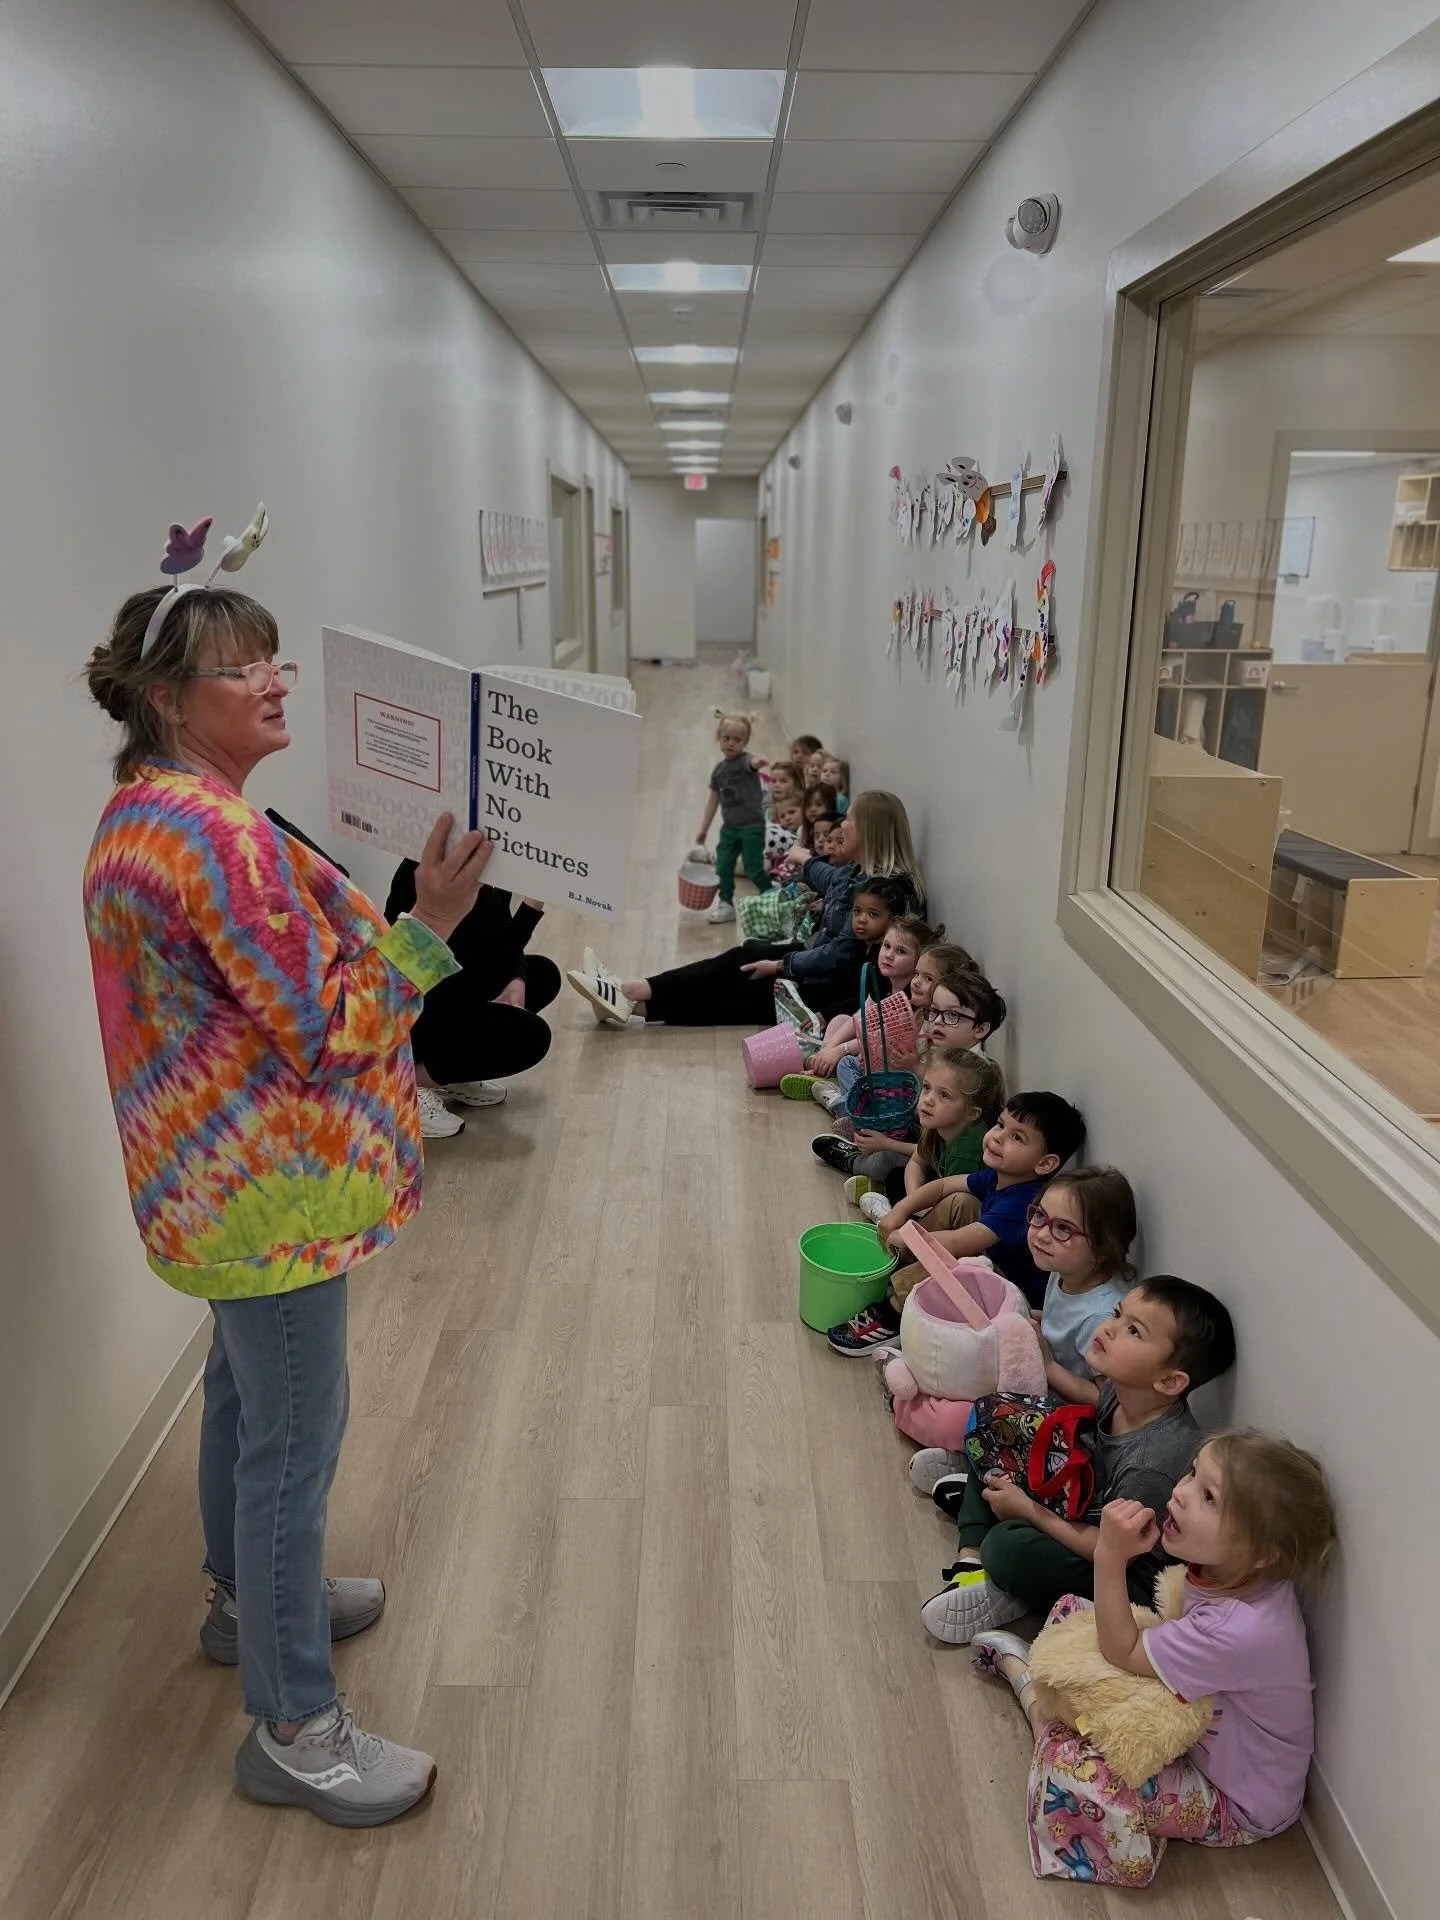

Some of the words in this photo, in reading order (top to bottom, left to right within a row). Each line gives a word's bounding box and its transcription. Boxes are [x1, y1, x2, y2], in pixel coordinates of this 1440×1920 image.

[488, 690, 539, 725] The
[487, 724, 553, 765] Book
[485, 759, 551, 800] With
[485, 792, 522, 823] No
[484, 825, 589, 878] Pictures
[585, 896, 613, 912] Novak
